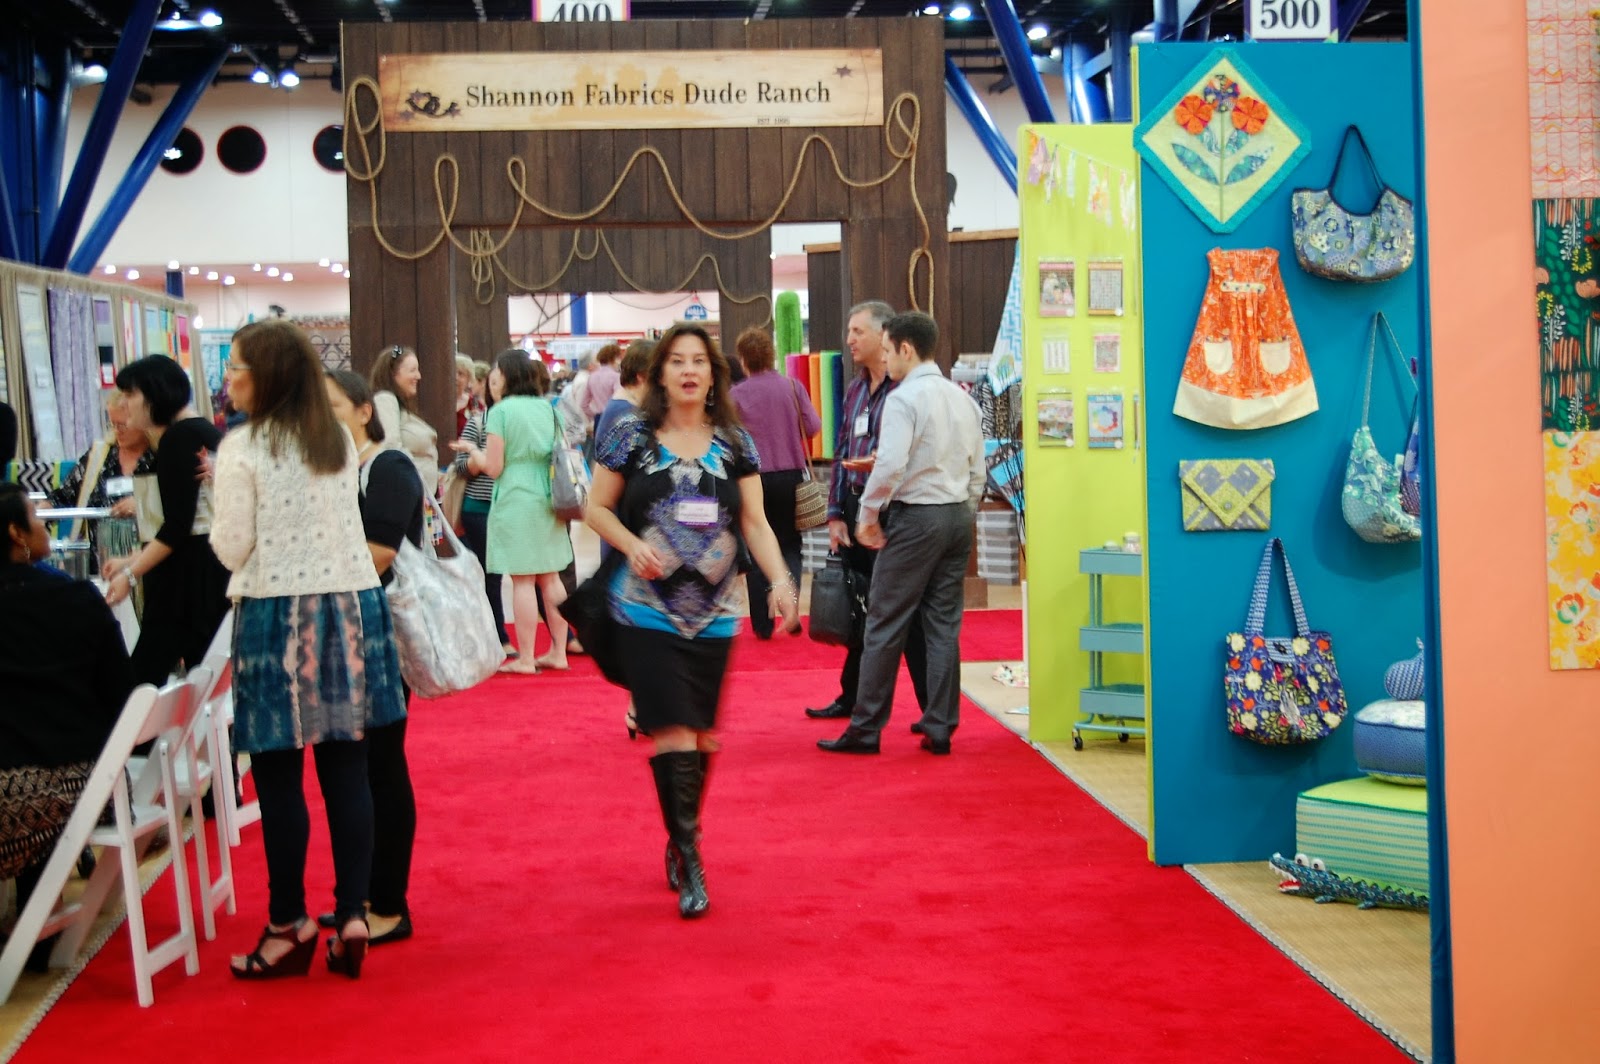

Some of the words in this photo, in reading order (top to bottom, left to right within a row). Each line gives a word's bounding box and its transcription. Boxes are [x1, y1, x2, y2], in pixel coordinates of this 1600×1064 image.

[1261, 0, 1320, 29] 500
[466, 84, 575, 108] Shannon
[585, 81, 675, 107] Fabrics
[684, 81, 748, 106] Dude
[757, 80, 831, 104] Ranch
